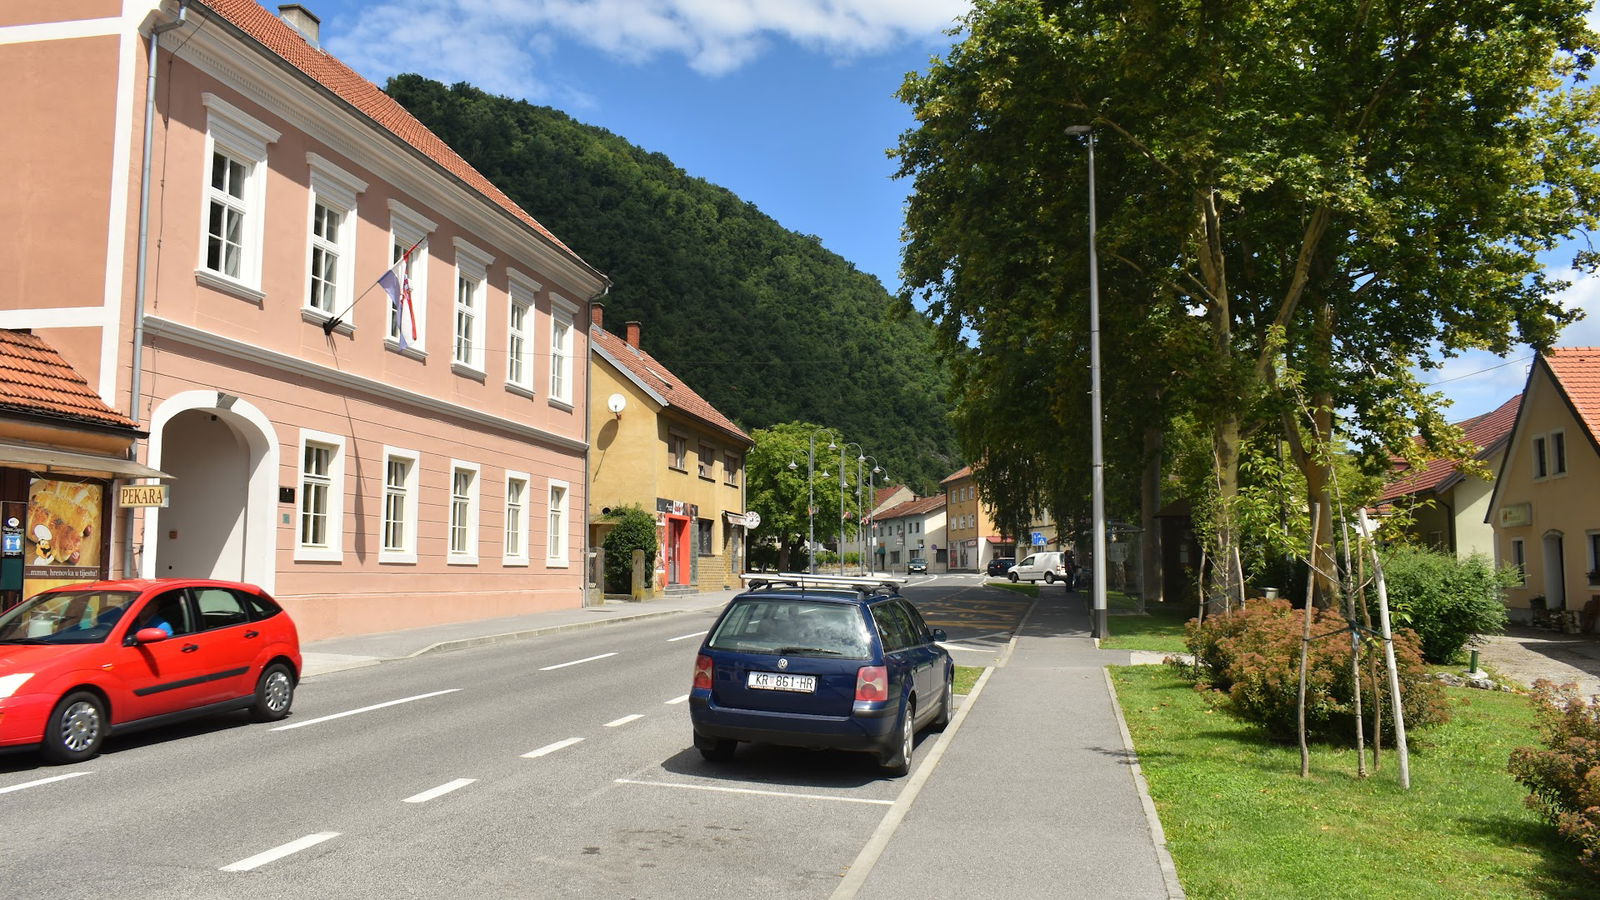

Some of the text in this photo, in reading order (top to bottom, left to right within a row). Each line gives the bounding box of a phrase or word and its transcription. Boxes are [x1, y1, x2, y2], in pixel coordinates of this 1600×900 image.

[121, 488, 163, 504] PEKARA
[50, 568, 75, 577] hrenovka
[756, 674, 768, 685] KR
